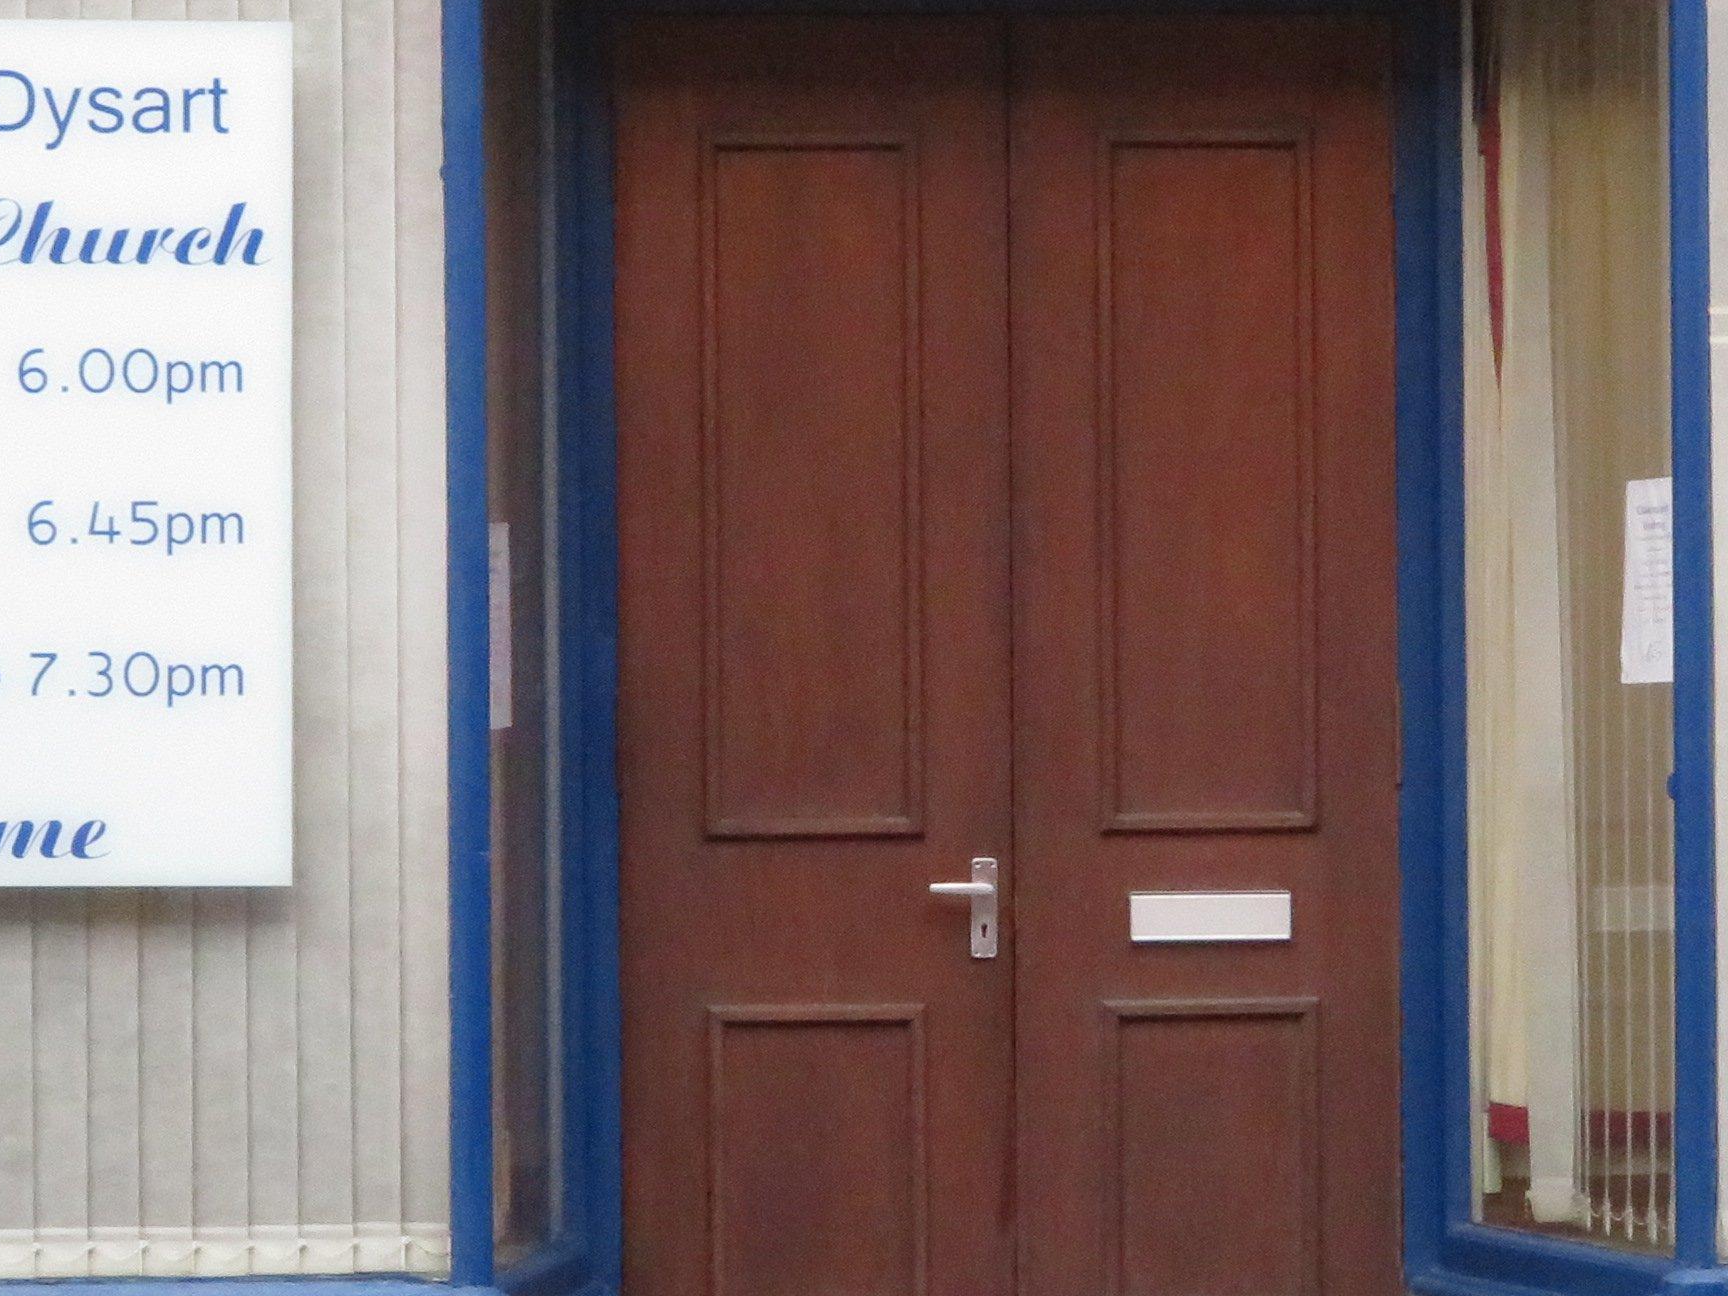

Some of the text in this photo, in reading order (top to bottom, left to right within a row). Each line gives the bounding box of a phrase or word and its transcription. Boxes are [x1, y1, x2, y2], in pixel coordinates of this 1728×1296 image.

[15, 345, 246, 406] 6.00pm
[25, 497, 247, 558] 6.45pm
[27, 648, 247, 711] 7.30pm
